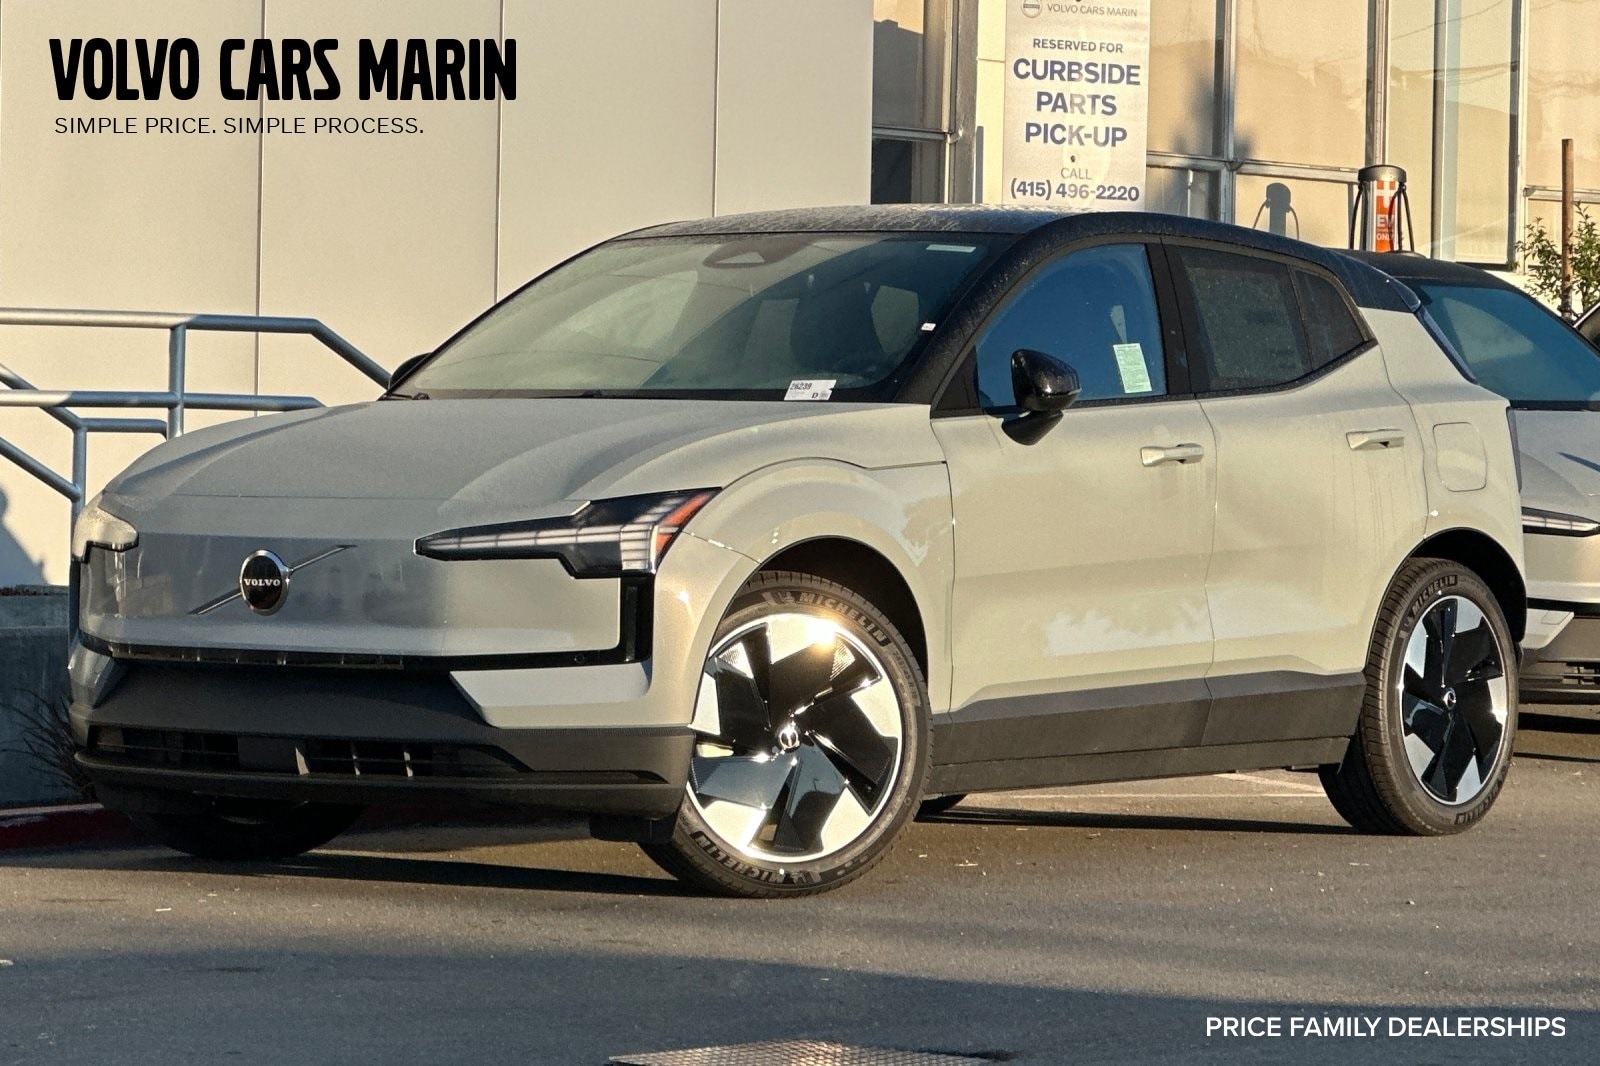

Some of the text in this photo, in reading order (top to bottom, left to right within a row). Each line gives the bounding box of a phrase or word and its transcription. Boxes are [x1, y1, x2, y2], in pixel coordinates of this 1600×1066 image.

[1047, 3, 1078, 14] VOLVO
[1080, 5, 1105, 16] CARS
[1107, 7, 1138, 17] MARIN
[1033, 38, 1123, 54] RESERVED FOR
[1013, 57, 1141, 86] CURBSIDE
[1036, 91, 1117, 116] PARTS
[1025, 122, 1128, 148] PICK-UP
[1060, 167, 1093, 181] CALL
[1010, 178, 1140, 202] (415) 496-2220
[1412, 575, 1456, 616] MICHELIN
[800, 592, 888, 644] MICHELIN
[695, 833, 786, 884] MICHELIN
